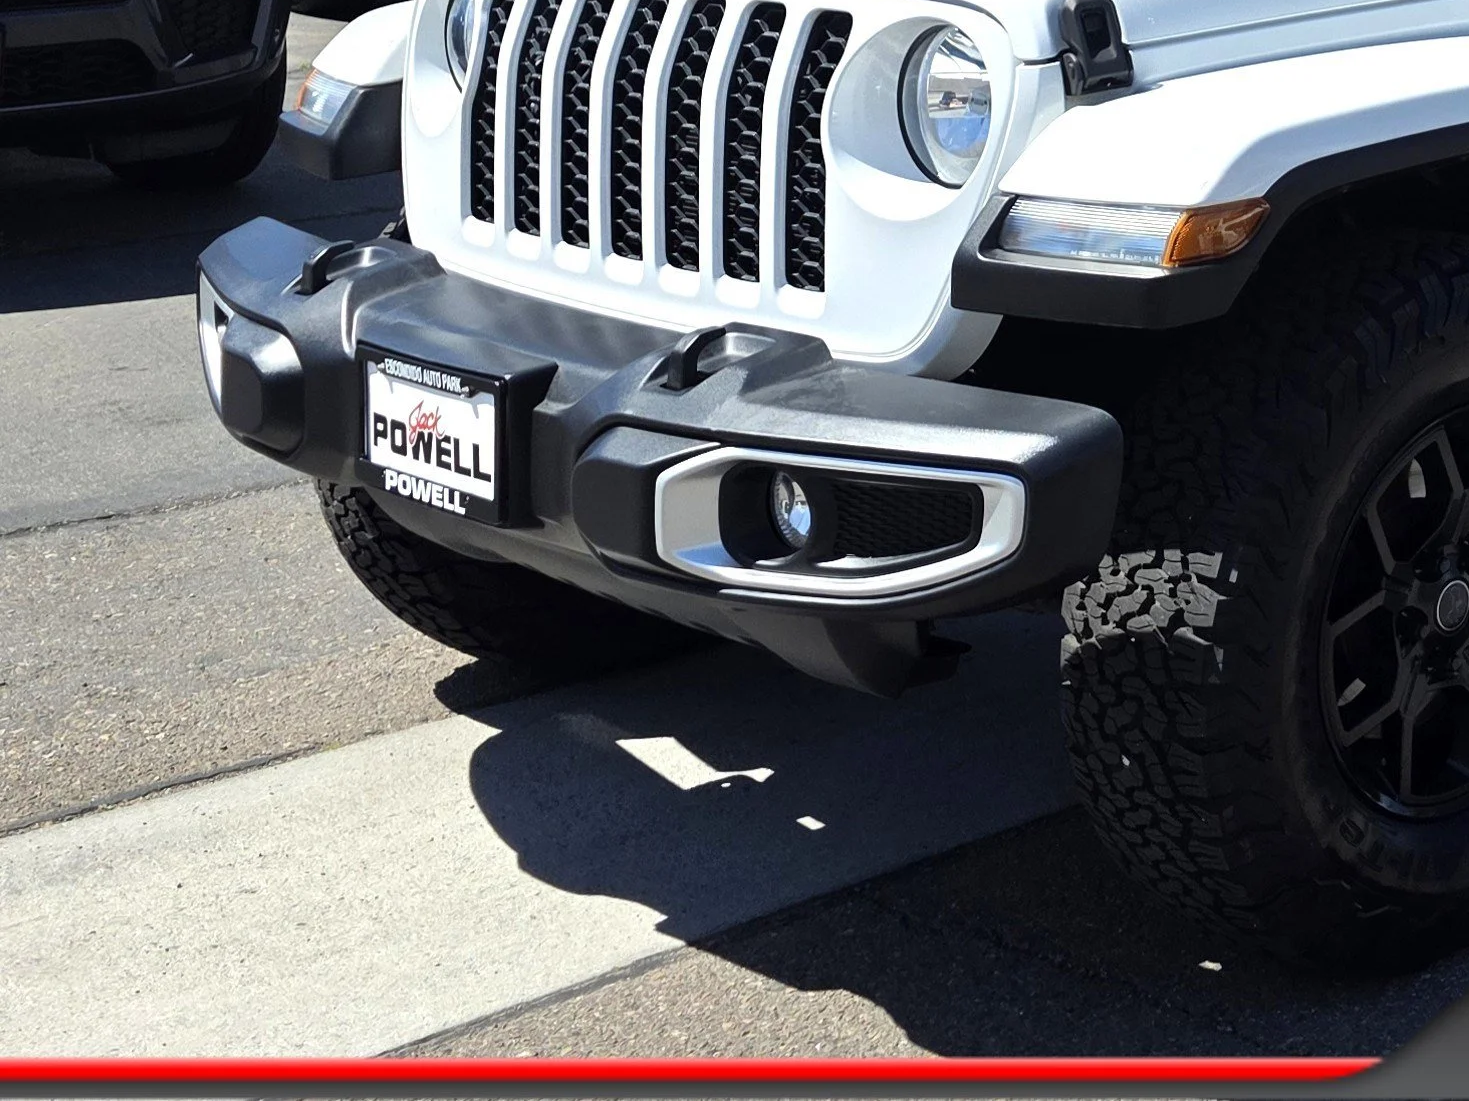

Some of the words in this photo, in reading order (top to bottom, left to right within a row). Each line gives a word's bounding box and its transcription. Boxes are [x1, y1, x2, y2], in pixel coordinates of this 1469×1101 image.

[385, 358, 423, 383] ESCONDIDO
[423, 369, 441, 388] AUTO
[442, 374, 463, 392] PARK
[409, 400, 445, 444] Jack
[374, 412, 491, 483] POWELL
[385, 469, 466, 515] POWELL
